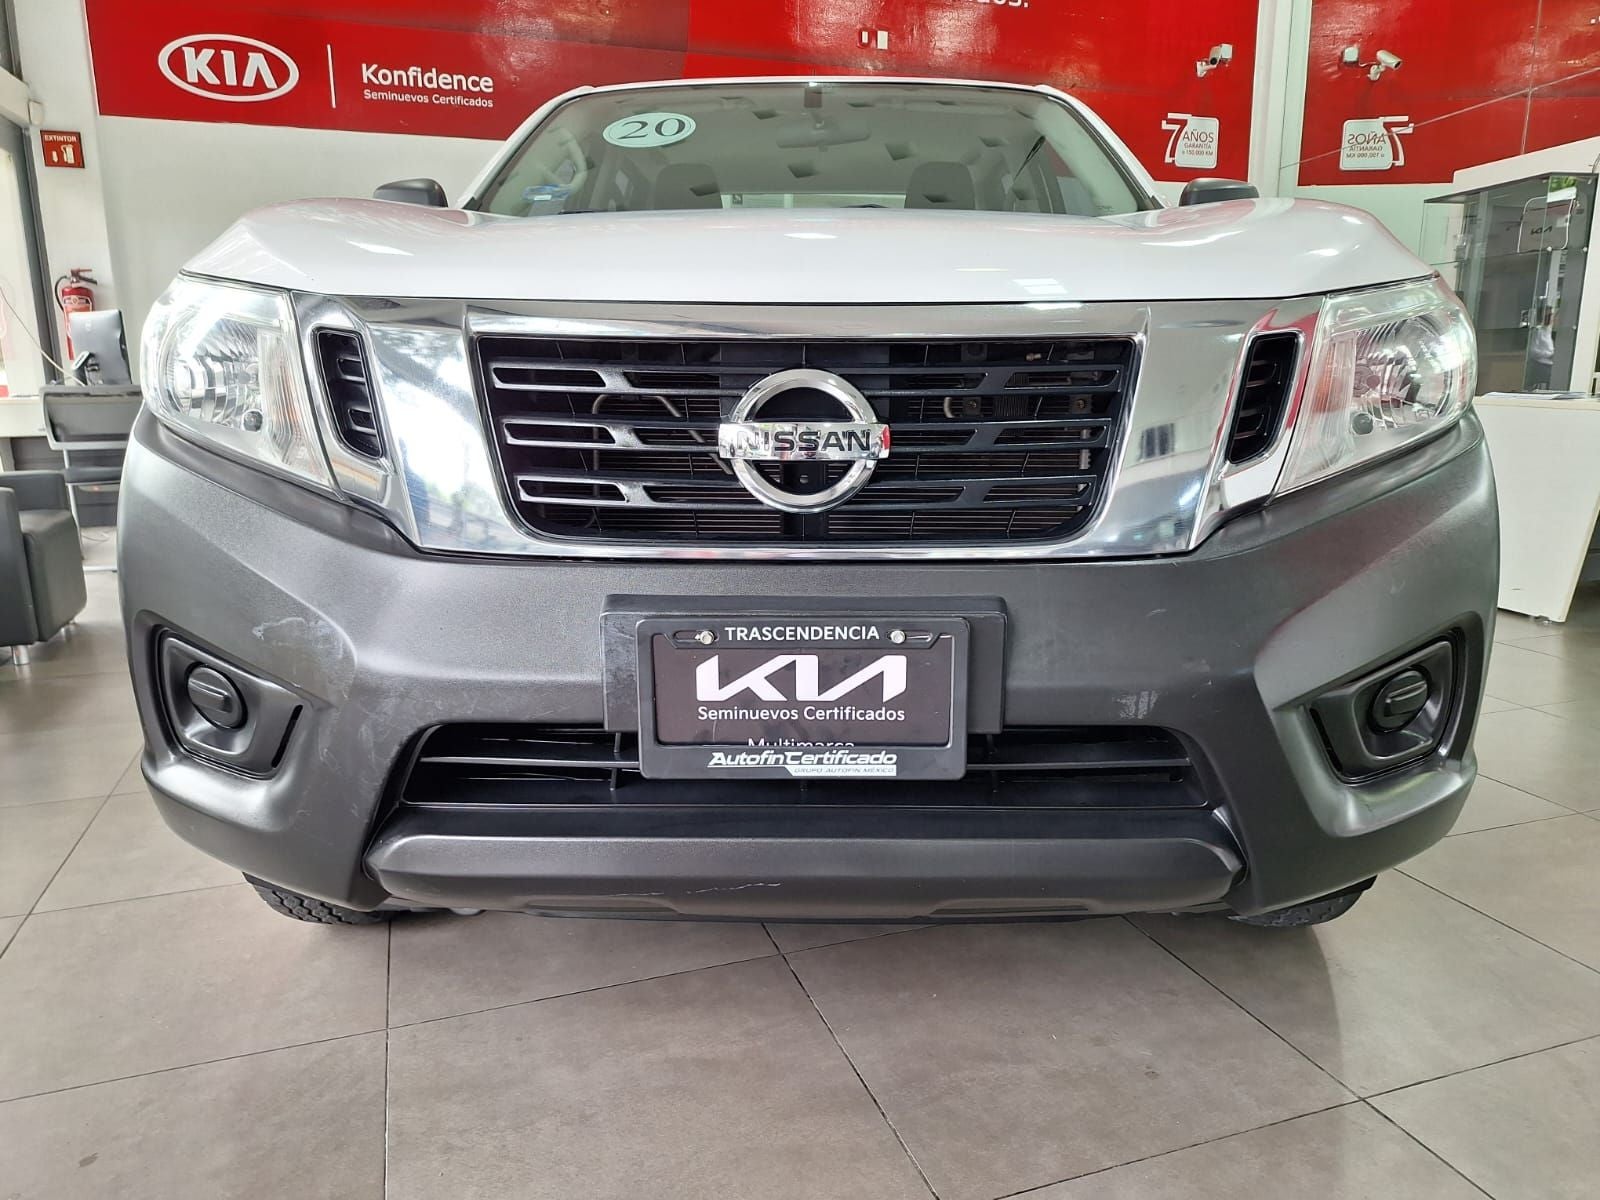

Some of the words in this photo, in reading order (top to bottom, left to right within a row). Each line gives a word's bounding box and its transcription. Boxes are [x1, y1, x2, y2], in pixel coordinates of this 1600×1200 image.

[182, 46, 279, 89] KIA
[361, 63, 494, 93] Konfidence
[363, 89, 429, 103] Seminuevos
[432, 94, 494, 108] Certificados
[44, 134, 77, 142] EXTINTOR
[616, 118, 687, 140] 20
[1182, 129, 1214, 143] AÑOS
[737, 430, 872, 452] NISSAN
[724, 625, 880, 641] TRASCENDENCIA
[695, 654, 908, 703] KIA
[697, 706, 799, 721] Seminuevos
[803, 706, 905, 721] Certificados
